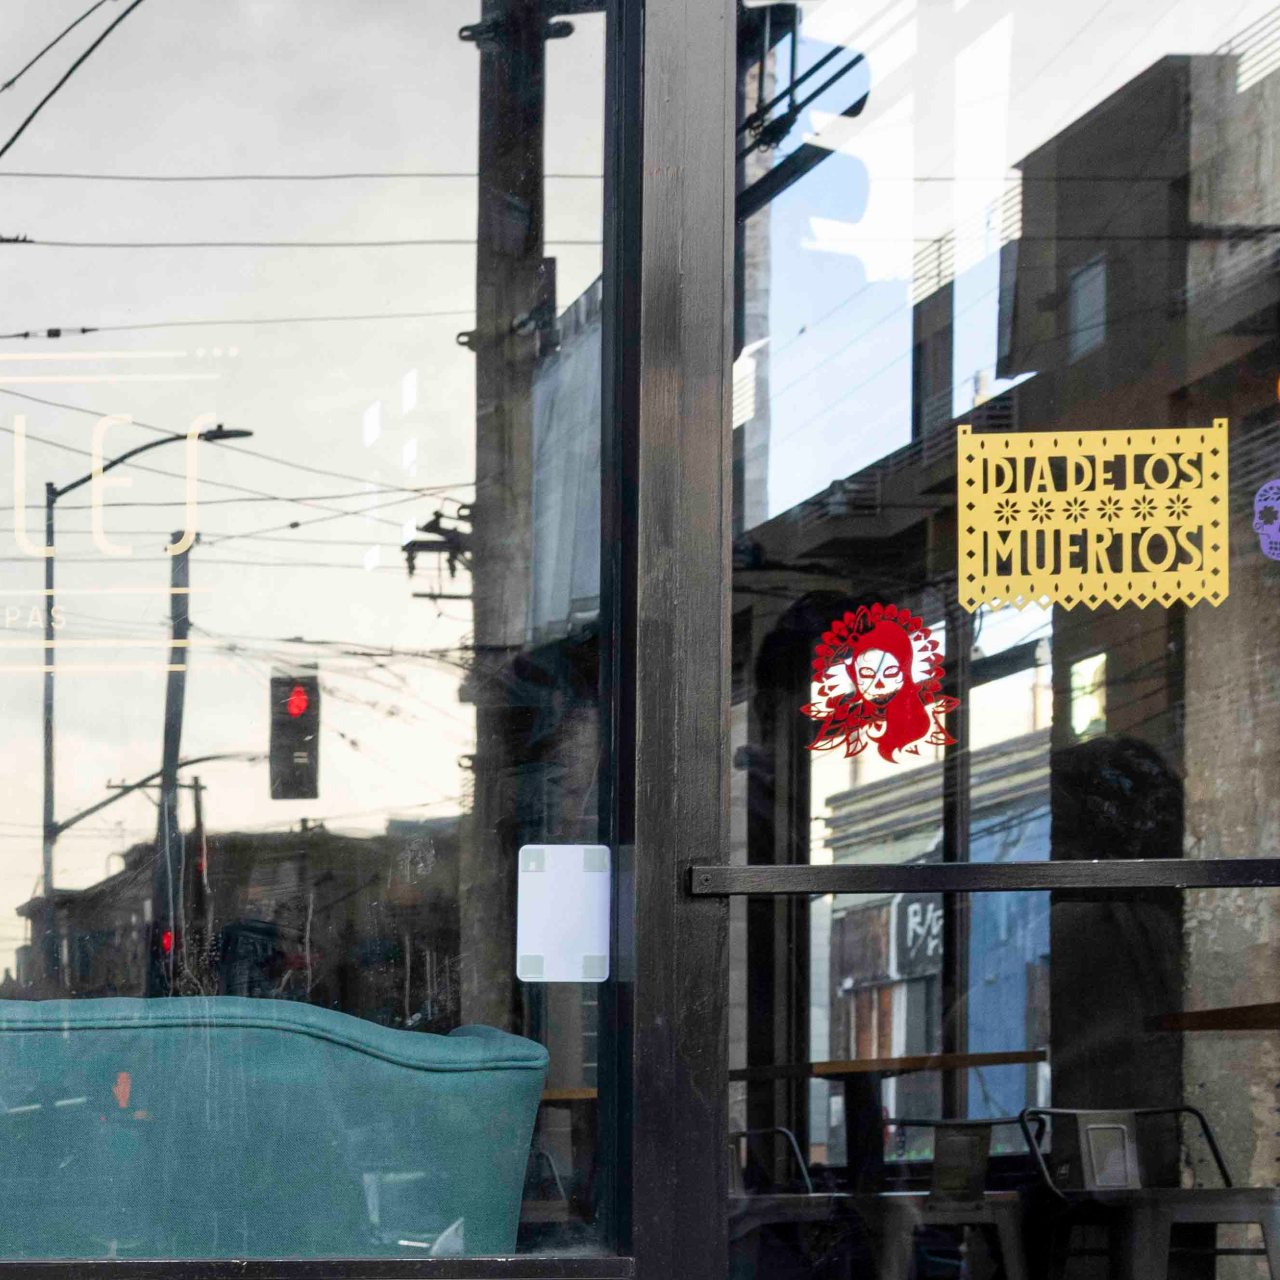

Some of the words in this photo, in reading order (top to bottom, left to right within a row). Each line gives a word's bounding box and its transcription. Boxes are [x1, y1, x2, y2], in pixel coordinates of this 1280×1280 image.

[987, 455, 1058, 494] DIA
[1067, 454, 1116, 493] DE
[1126, 451, 1203, 491] LOS
[987, 524, 1204, 578] MUERTOS
